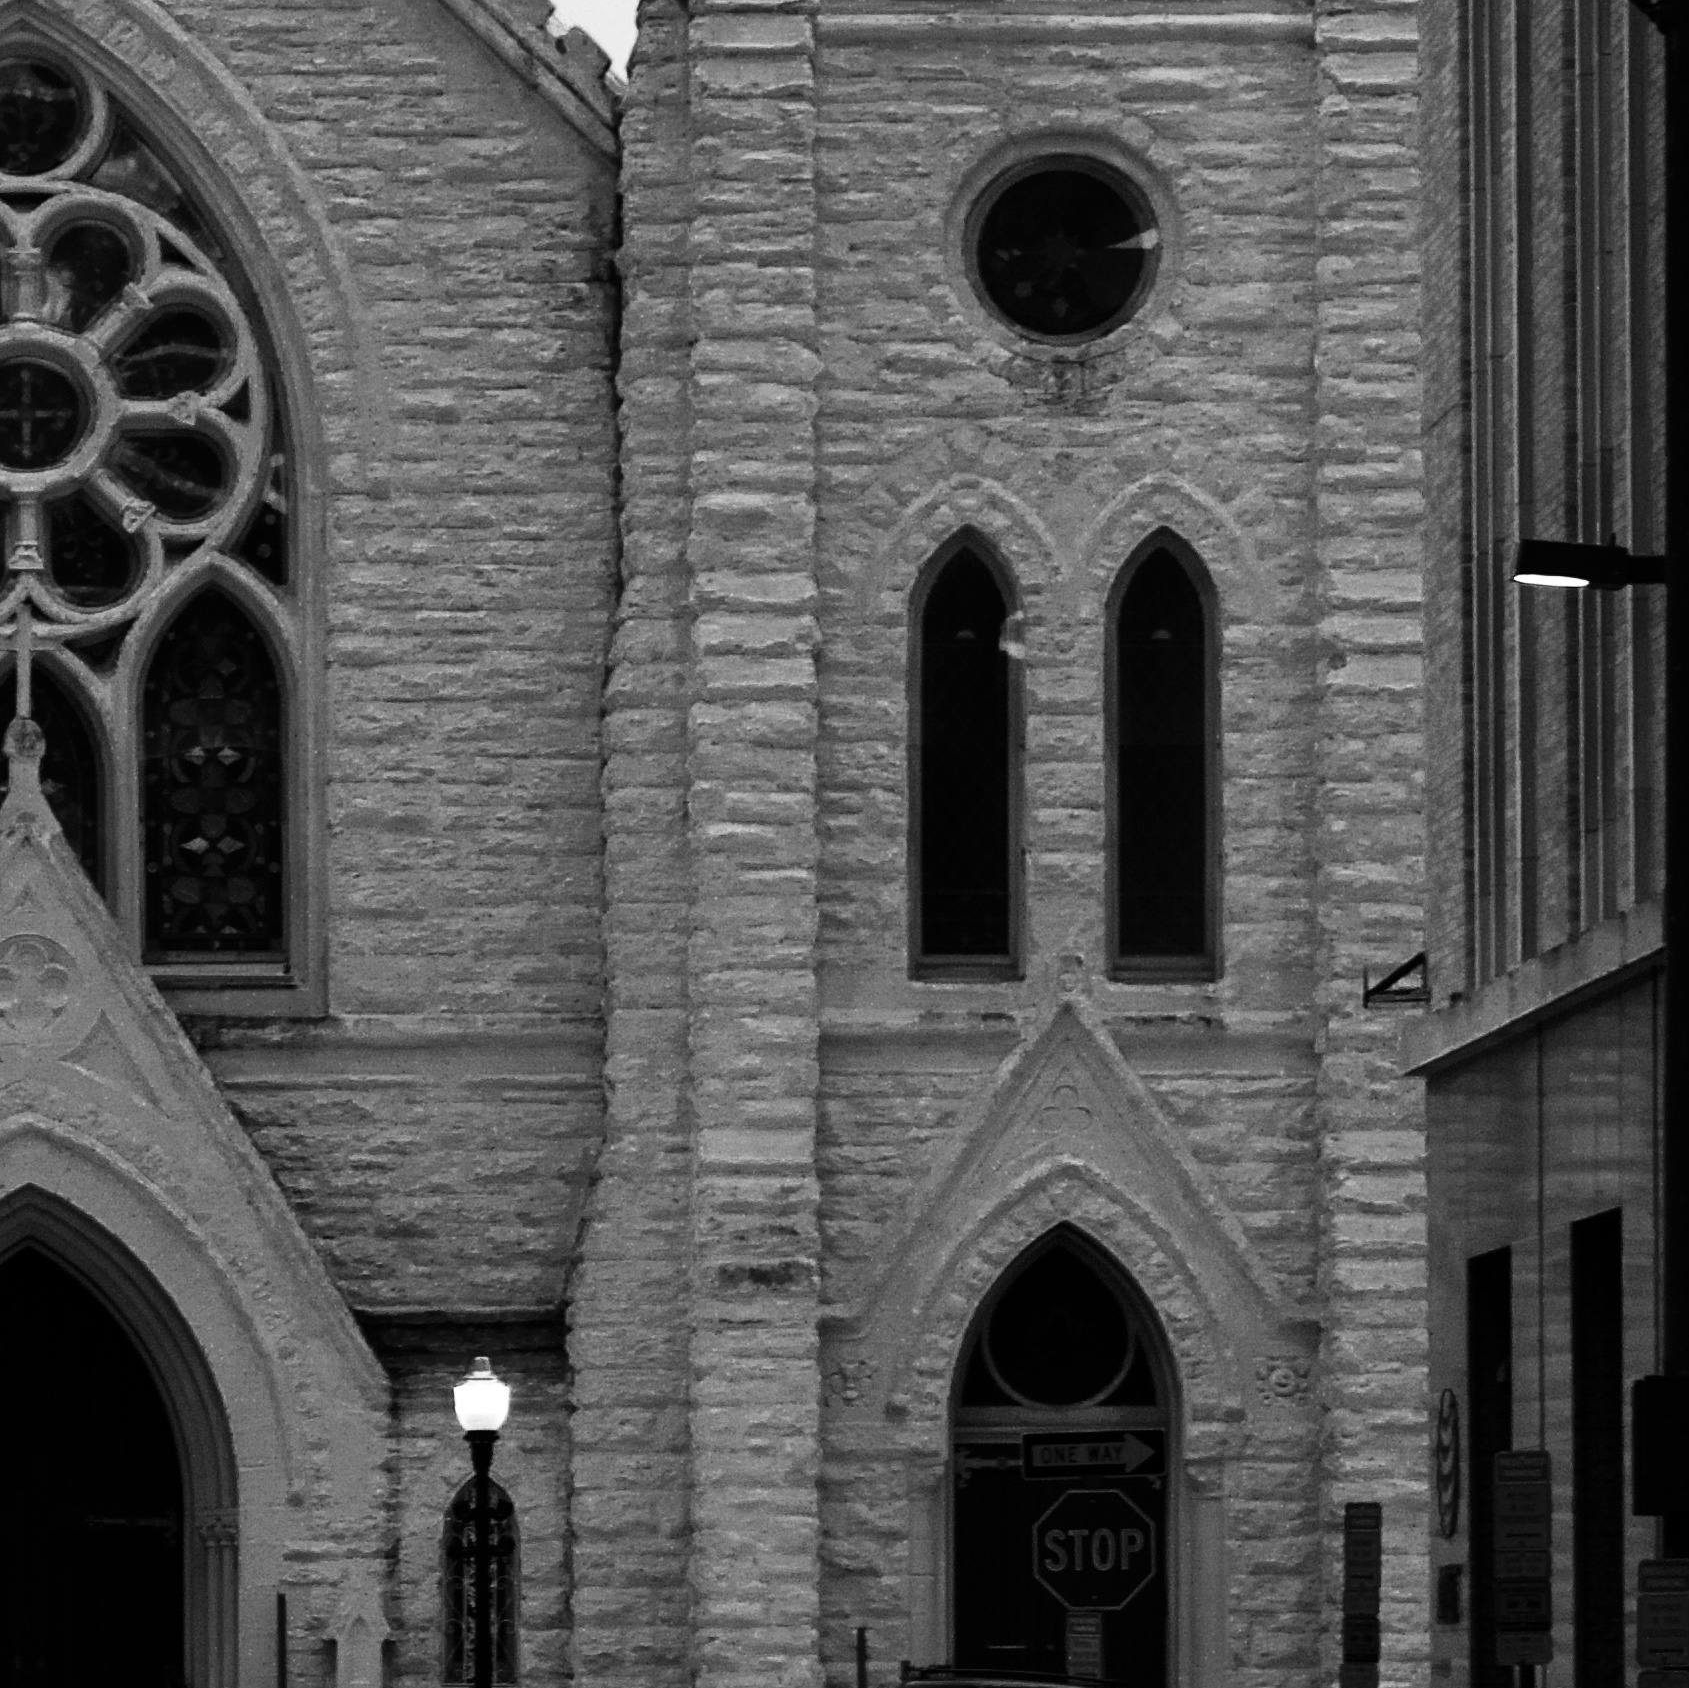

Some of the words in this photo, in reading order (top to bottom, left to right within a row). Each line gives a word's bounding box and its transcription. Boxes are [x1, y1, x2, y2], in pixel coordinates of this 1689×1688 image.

[1040, 1447, 1078, 1464] ONE
[1088, 1446, 1123, 1463] WAY
[1043, 1527, 1144, 1571] STOP
